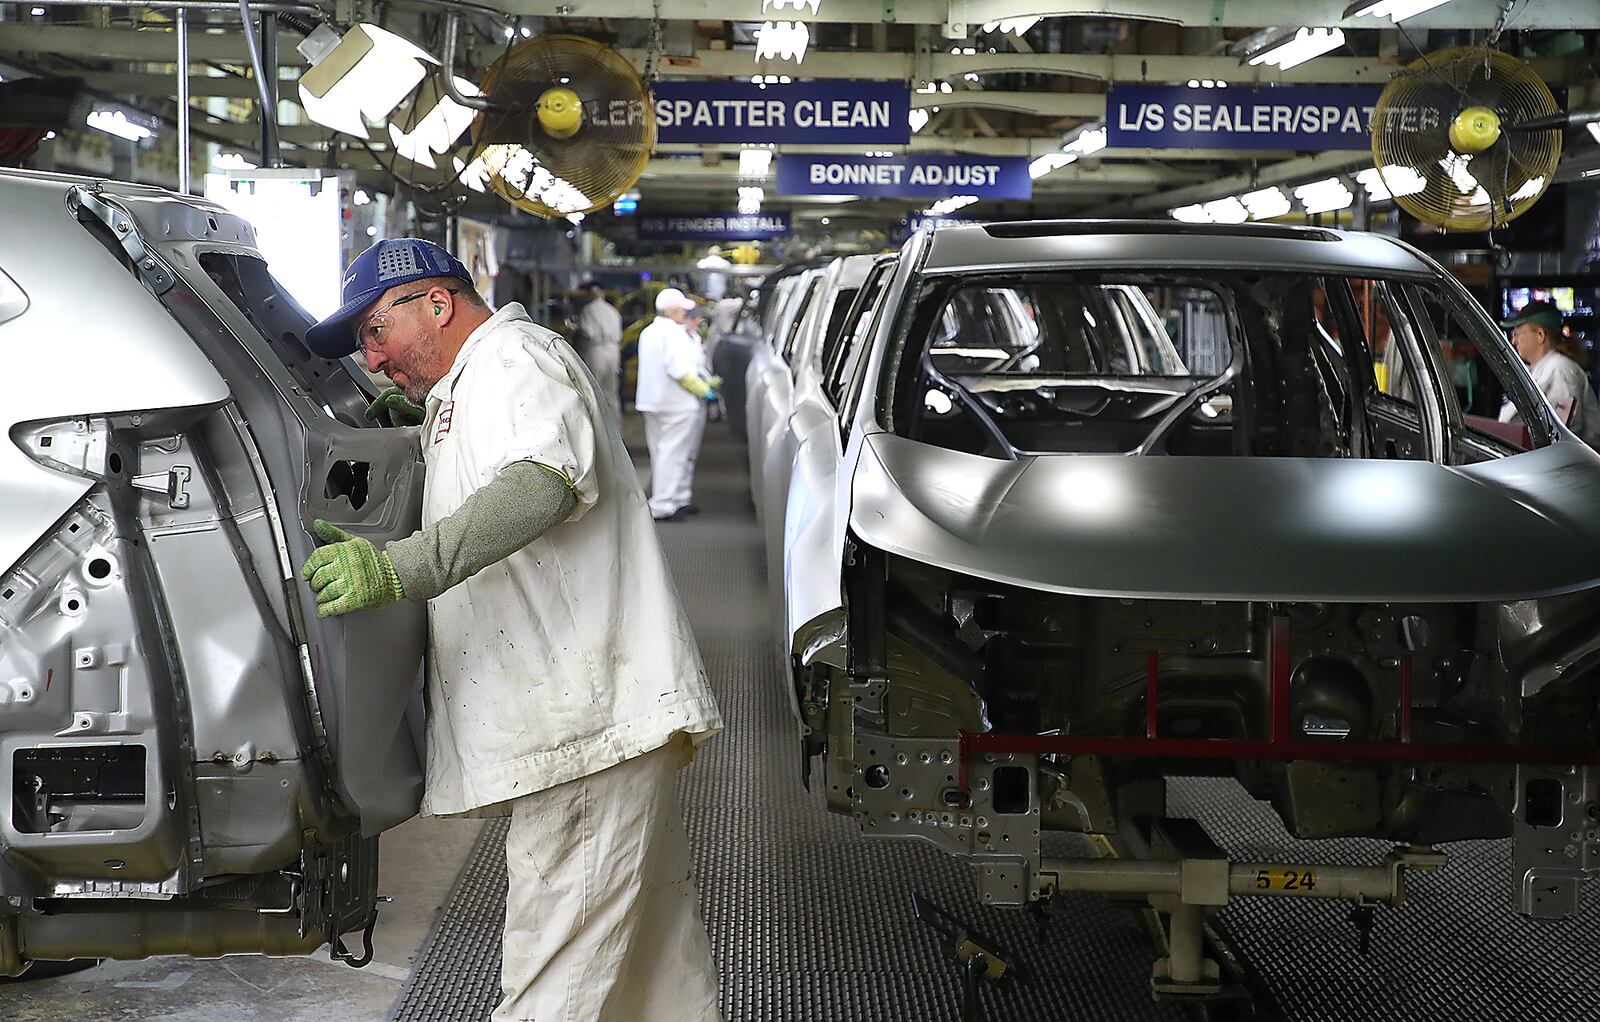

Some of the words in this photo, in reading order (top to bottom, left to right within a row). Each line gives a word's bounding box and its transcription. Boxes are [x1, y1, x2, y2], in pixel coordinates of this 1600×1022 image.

[792, 98, 891, 129] CLEAN
[1118, 103, 1166, 134] L/S
[809, 163, 904, 186] BONNET
[909, 163, 1001, 186] ADJUST
[668, 217, 725, 232] FENDER
[726, 217, 786, 232] INSTALL
[1256, 870, 1271, 889] 5
[1283, 870, 1315, 891] 24
